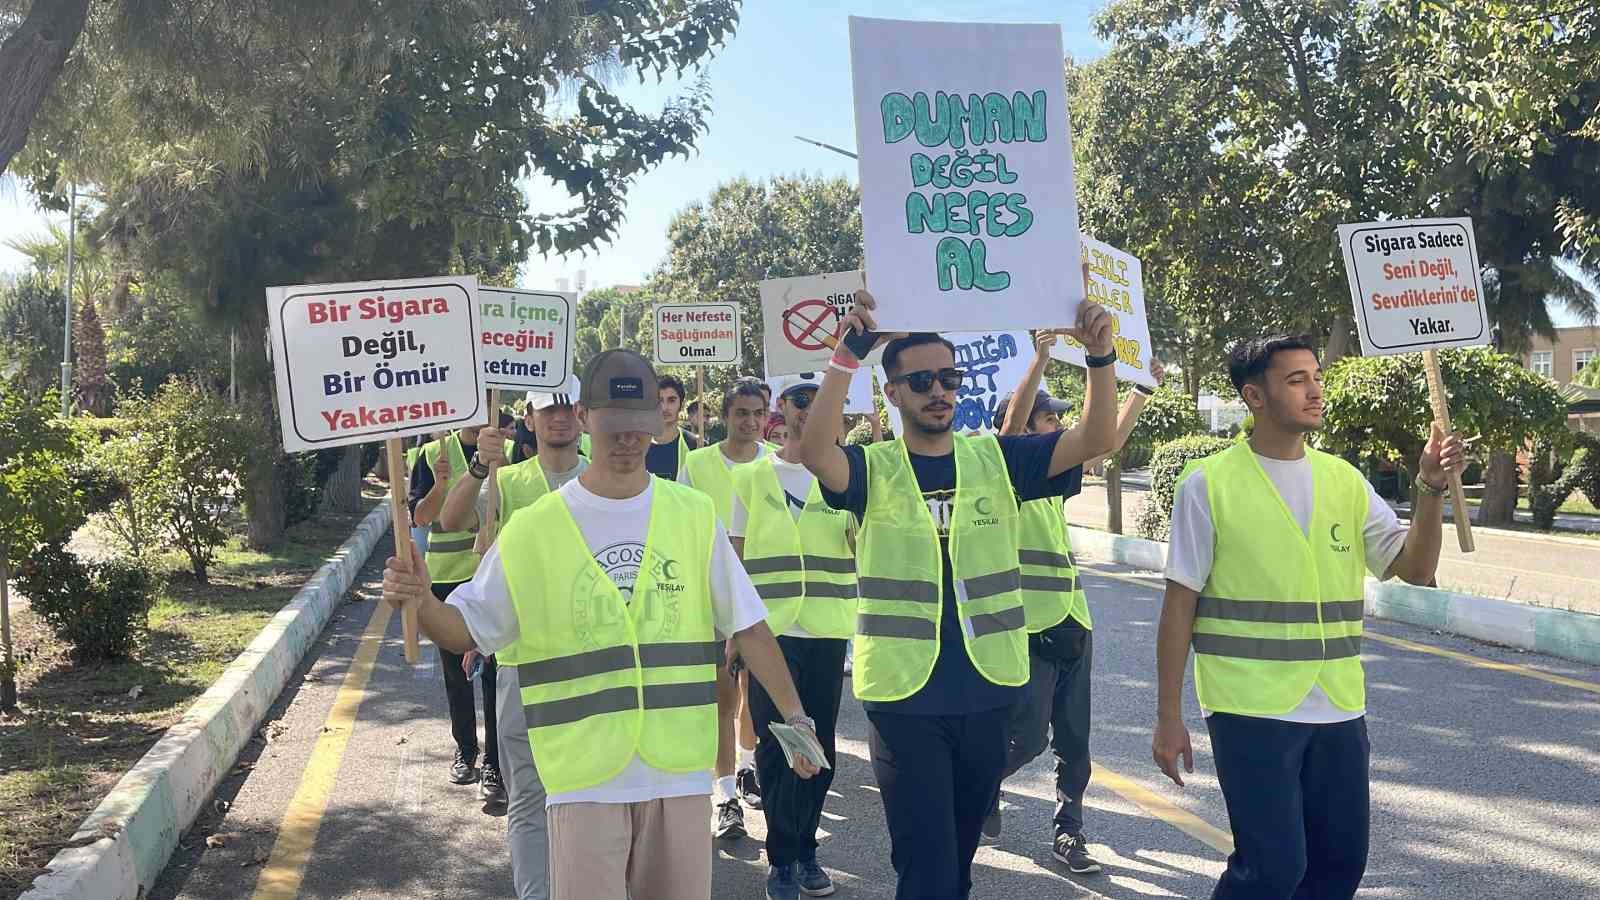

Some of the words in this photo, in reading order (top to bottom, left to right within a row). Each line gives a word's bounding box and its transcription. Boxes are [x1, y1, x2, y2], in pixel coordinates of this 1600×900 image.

[881, 90, 1047, 148] DUMAN
[910, 149, 1018, 189] DEĞİL
[906, 190, 1033, 237] NEFES
[1365, 234, 1416, 256] Sigara
[1418, 231, 1464, 248] Sadece
[936, 236, 1011, 292] AL
[1383, 261, 1416, 280] Seni
[1419, 258, 1458, 280] Değil,
[308, 301, 351, 324] Bir
[359, 296, 449, 322] Sigara
[510, 296, 563, 325] İçme,
[1372, 286, 1476, 310] Sevdiklerini'de
[662, 311, 683, 323] Her
[686, 311, 732, 323] Nefeste
[1409, 318, 1454, 335] Yakar.
[342, 331, 426, 359] Değil,
[482, 330, 554, 352] eceğini
[660, 329, 733, 343] Sağlığından
[679, 346, 716, 357] Olma!
[323, 373, 365, 396] Bir
[373, 361, 450, 390] Ömür
[321, 399, 456, 432] Yakarsın.
